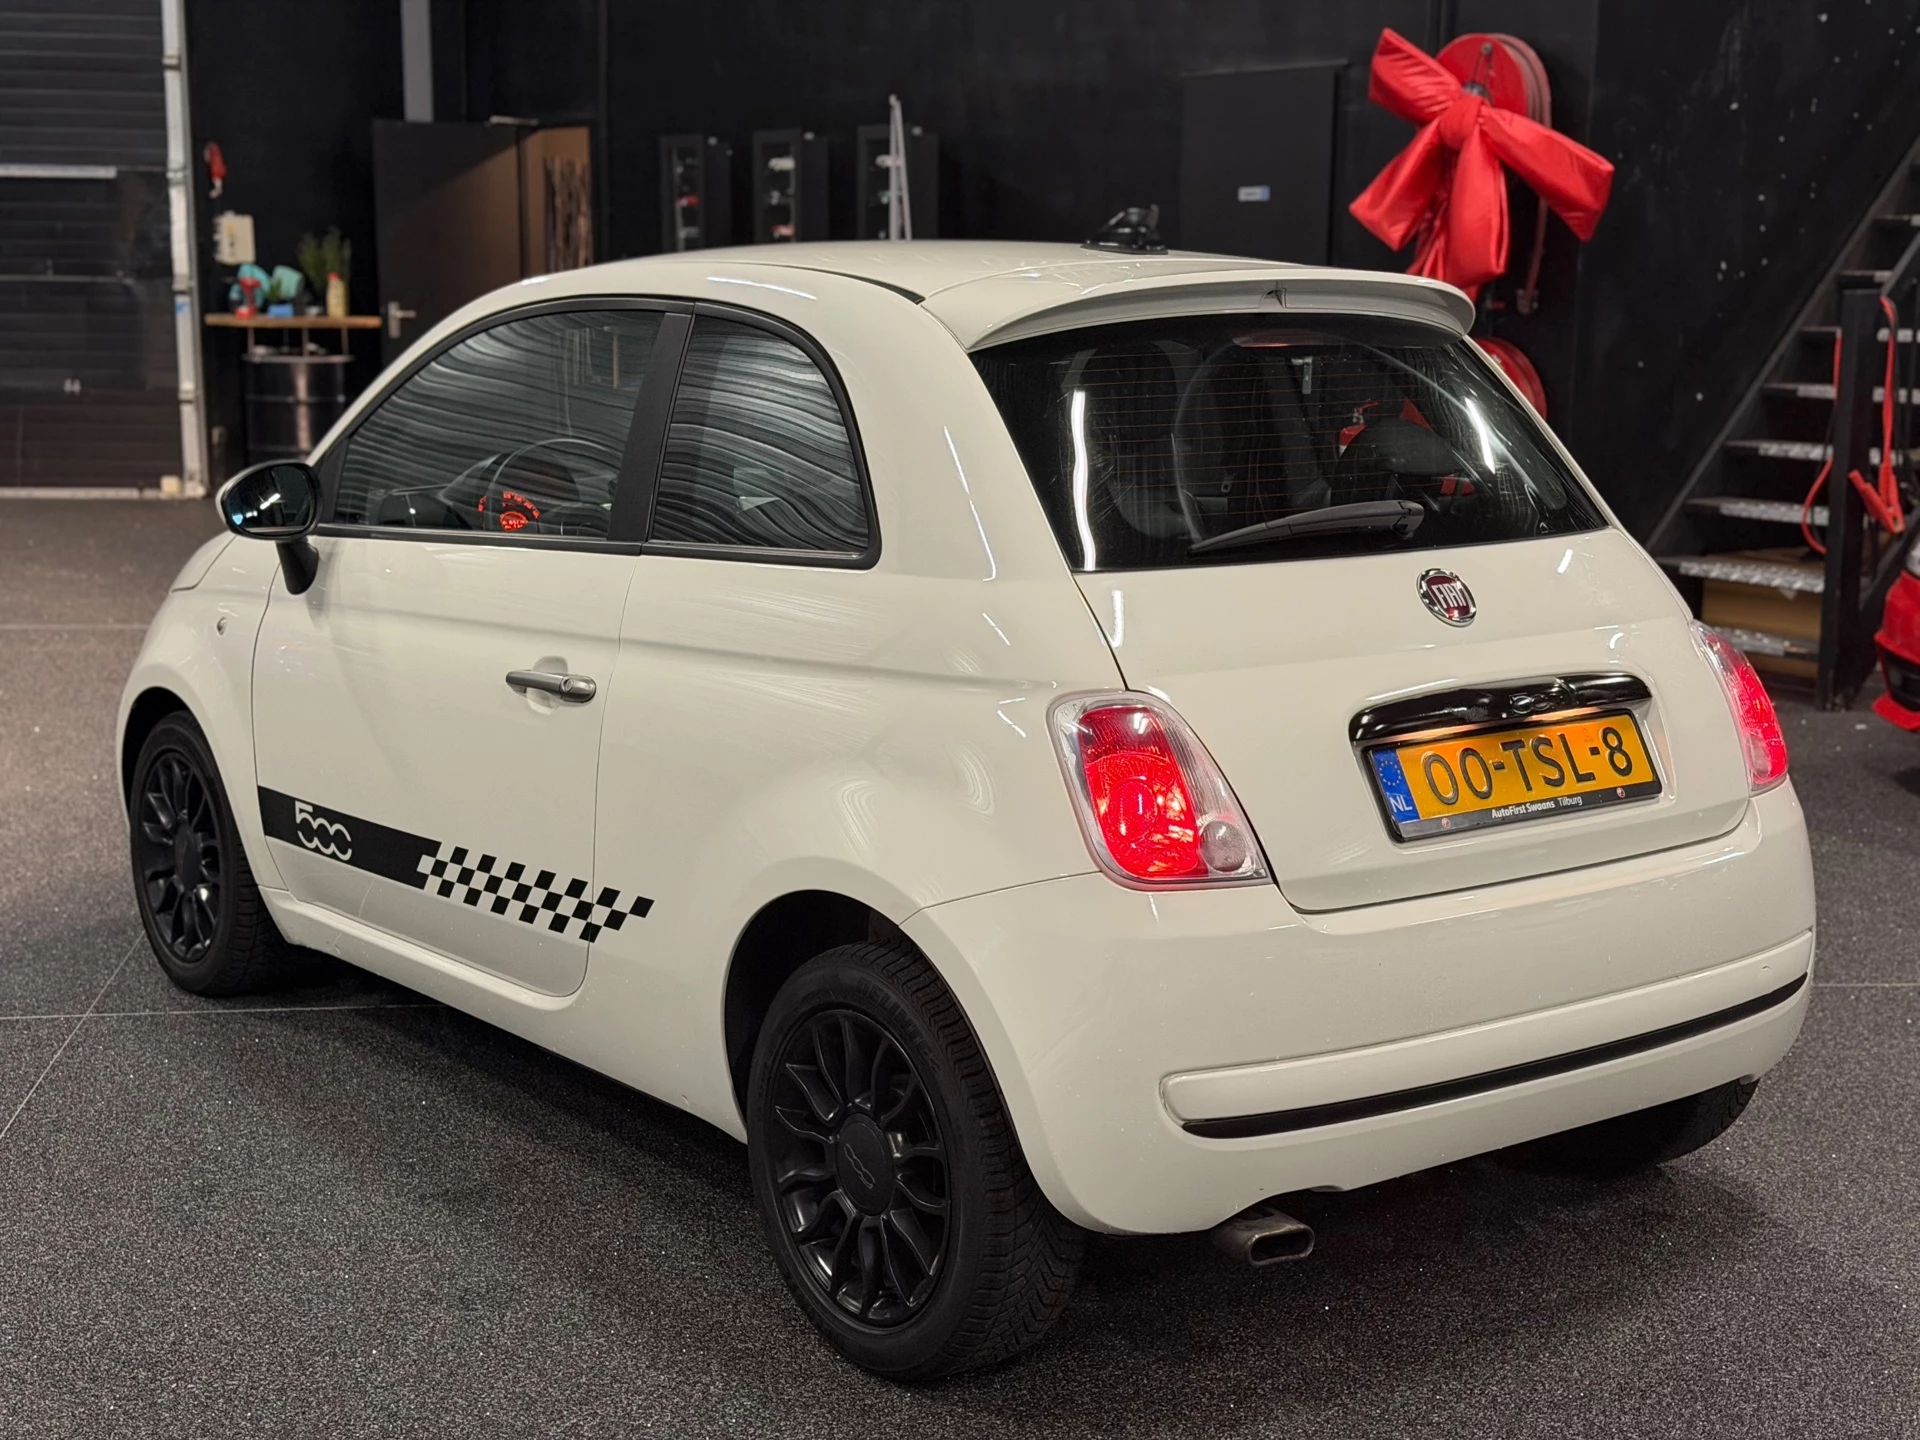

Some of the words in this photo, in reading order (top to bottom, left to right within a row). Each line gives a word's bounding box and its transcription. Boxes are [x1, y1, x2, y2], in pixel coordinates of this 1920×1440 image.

[1431, 582, 1467, 609] FIAT
[1424, 726, 1633, 806] 00-TSL-8
[1388, 795, 1412, 813] NL
[1491, 804, 1526, 819] AutoFirst
[1526, 801, 1555, 813] Swaans
[1558, 795, 1582, 807] Tilburg
[295, 800, 352, 861] 500
